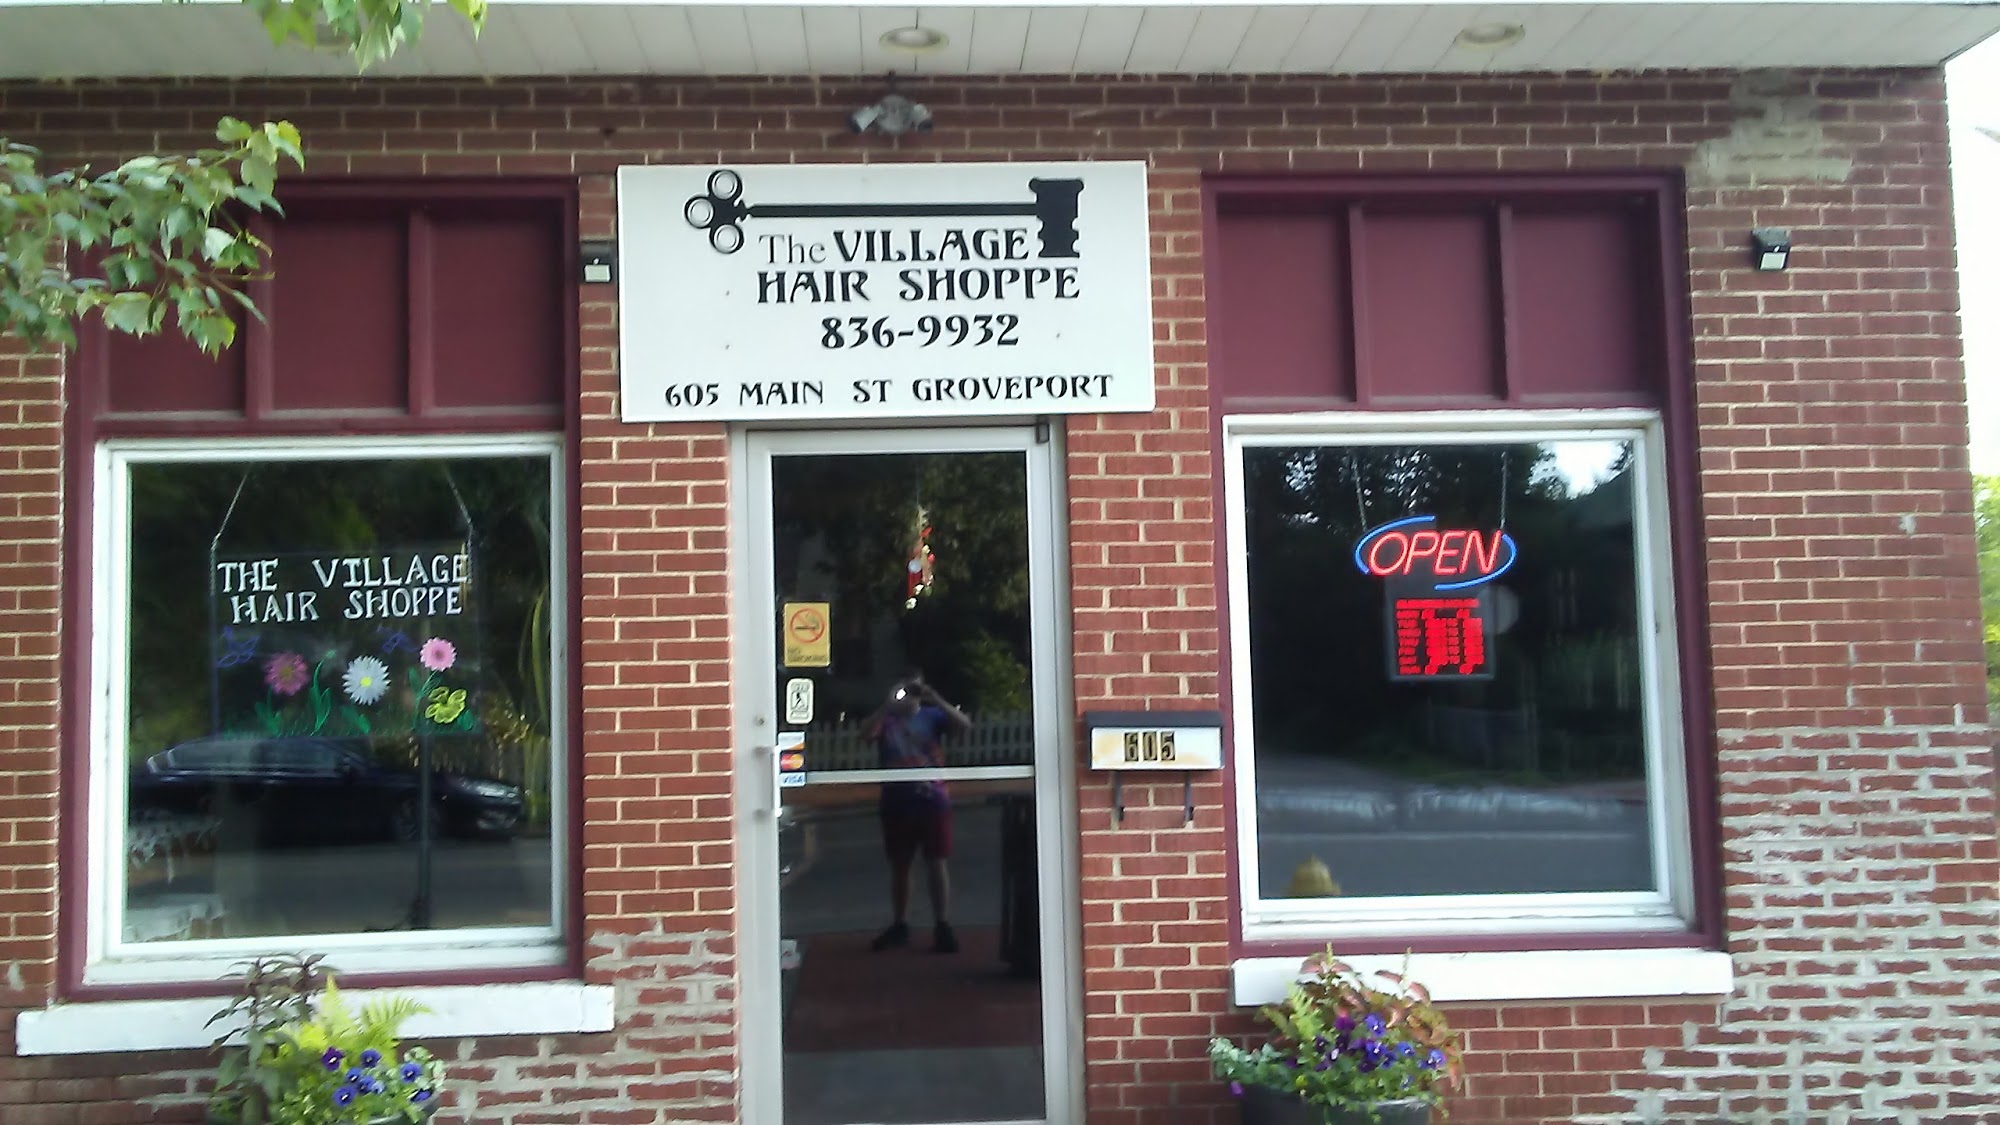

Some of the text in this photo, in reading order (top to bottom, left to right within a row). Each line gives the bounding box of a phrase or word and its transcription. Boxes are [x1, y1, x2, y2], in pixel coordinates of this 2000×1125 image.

[758, 229, 1029, 263] The VILLAGE
[757, 267, 1080, 304] HAIR SHOPPE
[821, 315, 1020, 349] 836-9932
[665, 374, 1113, 407] 605 MAIN ST GROVEPORT
[1369, 530, 1502, 576] OPEN
[217, 554, 469, 593] THE VILLAGE
[230, 587, 462, 624] HAIR SHOPPE
[1125, 732, 1175, 761] 605
